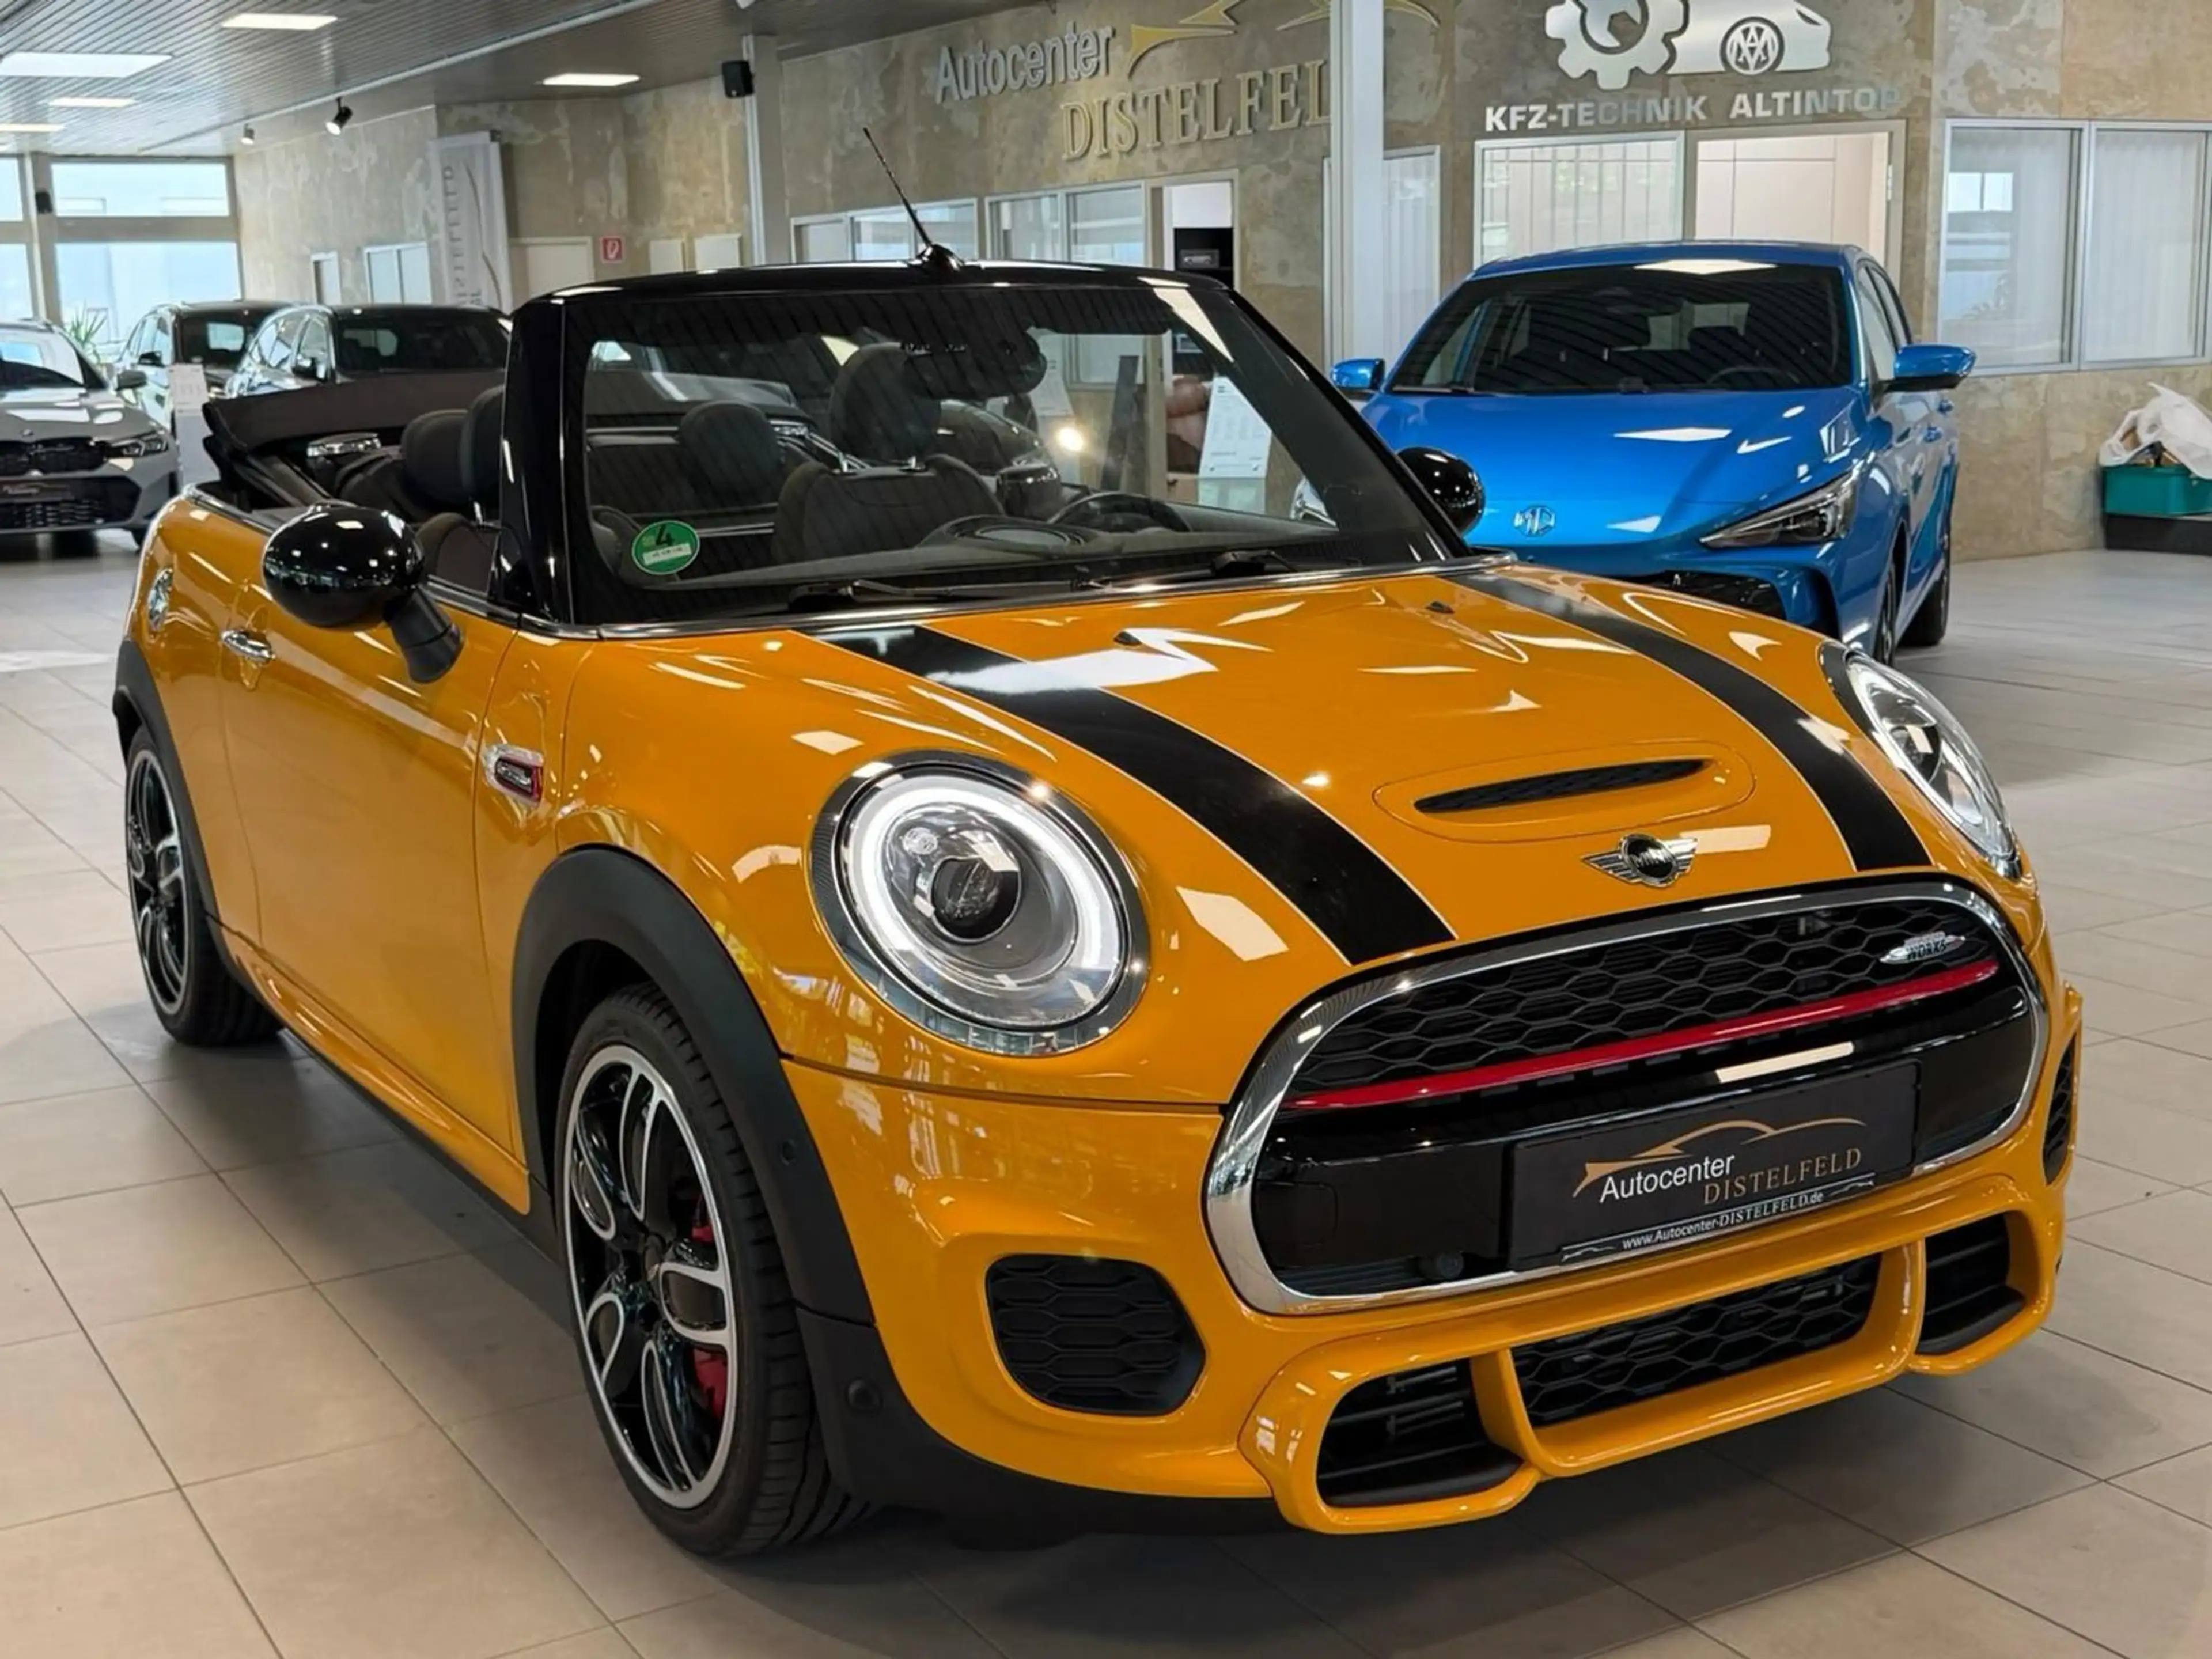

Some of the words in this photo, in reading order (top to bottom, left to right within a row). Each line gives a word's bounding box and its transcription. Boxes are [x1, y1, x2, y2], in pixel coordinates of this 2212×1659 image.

[935, 21, 1116, 104] Autocenter
[1060, 59, 1331, 162] DISTELFEL
[1485, 95, 1707, 132] KFZ-TECHNIK
[1729, 87, 1902, 119] ALTINTOP
[656, 524, 674, 546] 4
[1600, 1154, 1735, 1203] Autocenter
[1704, 1147, 1862, 1205] DISTELFELD
